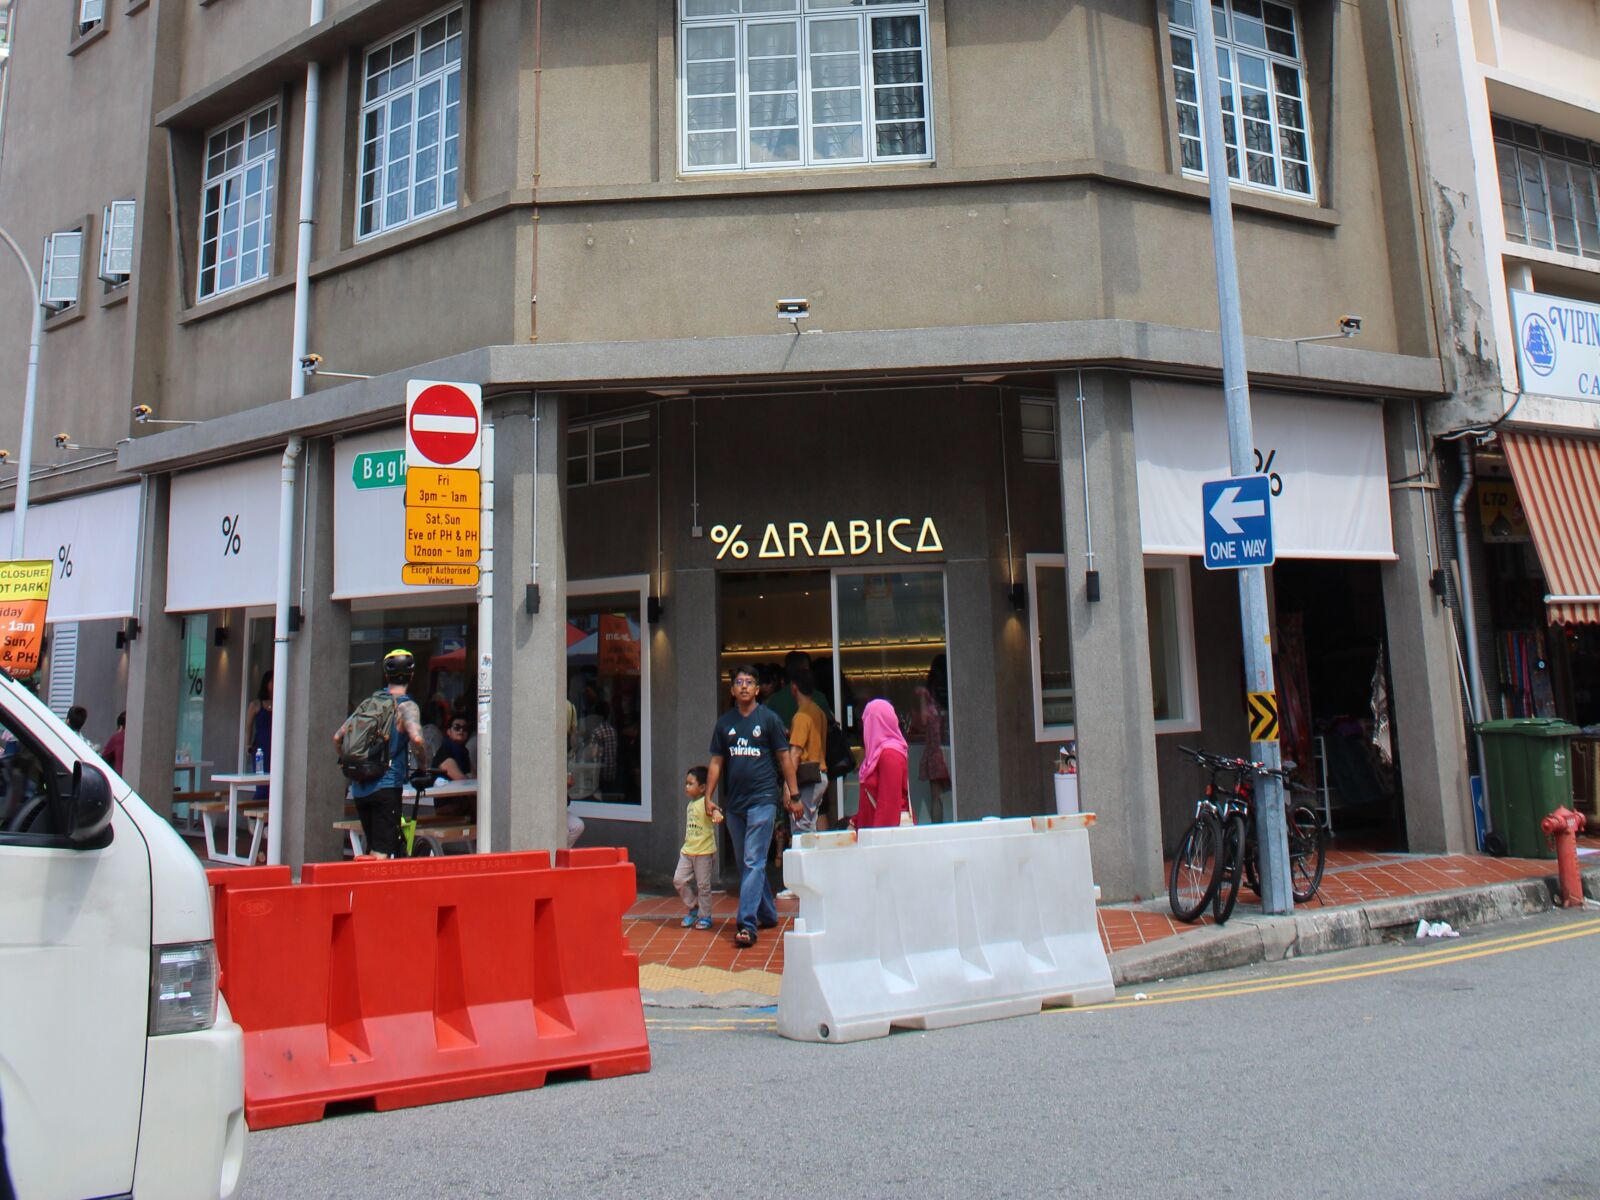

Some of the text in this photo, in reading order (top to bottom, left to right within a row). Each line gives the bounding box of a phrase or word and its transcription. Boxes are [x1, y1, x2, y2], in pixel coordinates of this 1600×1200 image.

[437, 475, 450, 486] Fri
[419, 490, 438, 503] 3pm
[451, 491, 467, 502] 1am
[222, 514, 241, 556] %
[408, 529, 478, 541] Eve of PH & PH
[710, 517, 944, 560] % ARABICA
[413, 545, 443, 557] 12noon
[456, 546, 472, 558] 1am
[1210, 539, 1267, 560] ONE WAY
[58, 543, 73, 579] %
[0, 568, 49, 579] CLOSURE!
[411, 566, 471, 575] Except Authorised
[428, 576, 454, 585] Vehicles
[13, 582, 48, 593] PARK!
[8, 620, 35, 632] 1am
[3, 651, 38, 663] & PH:
